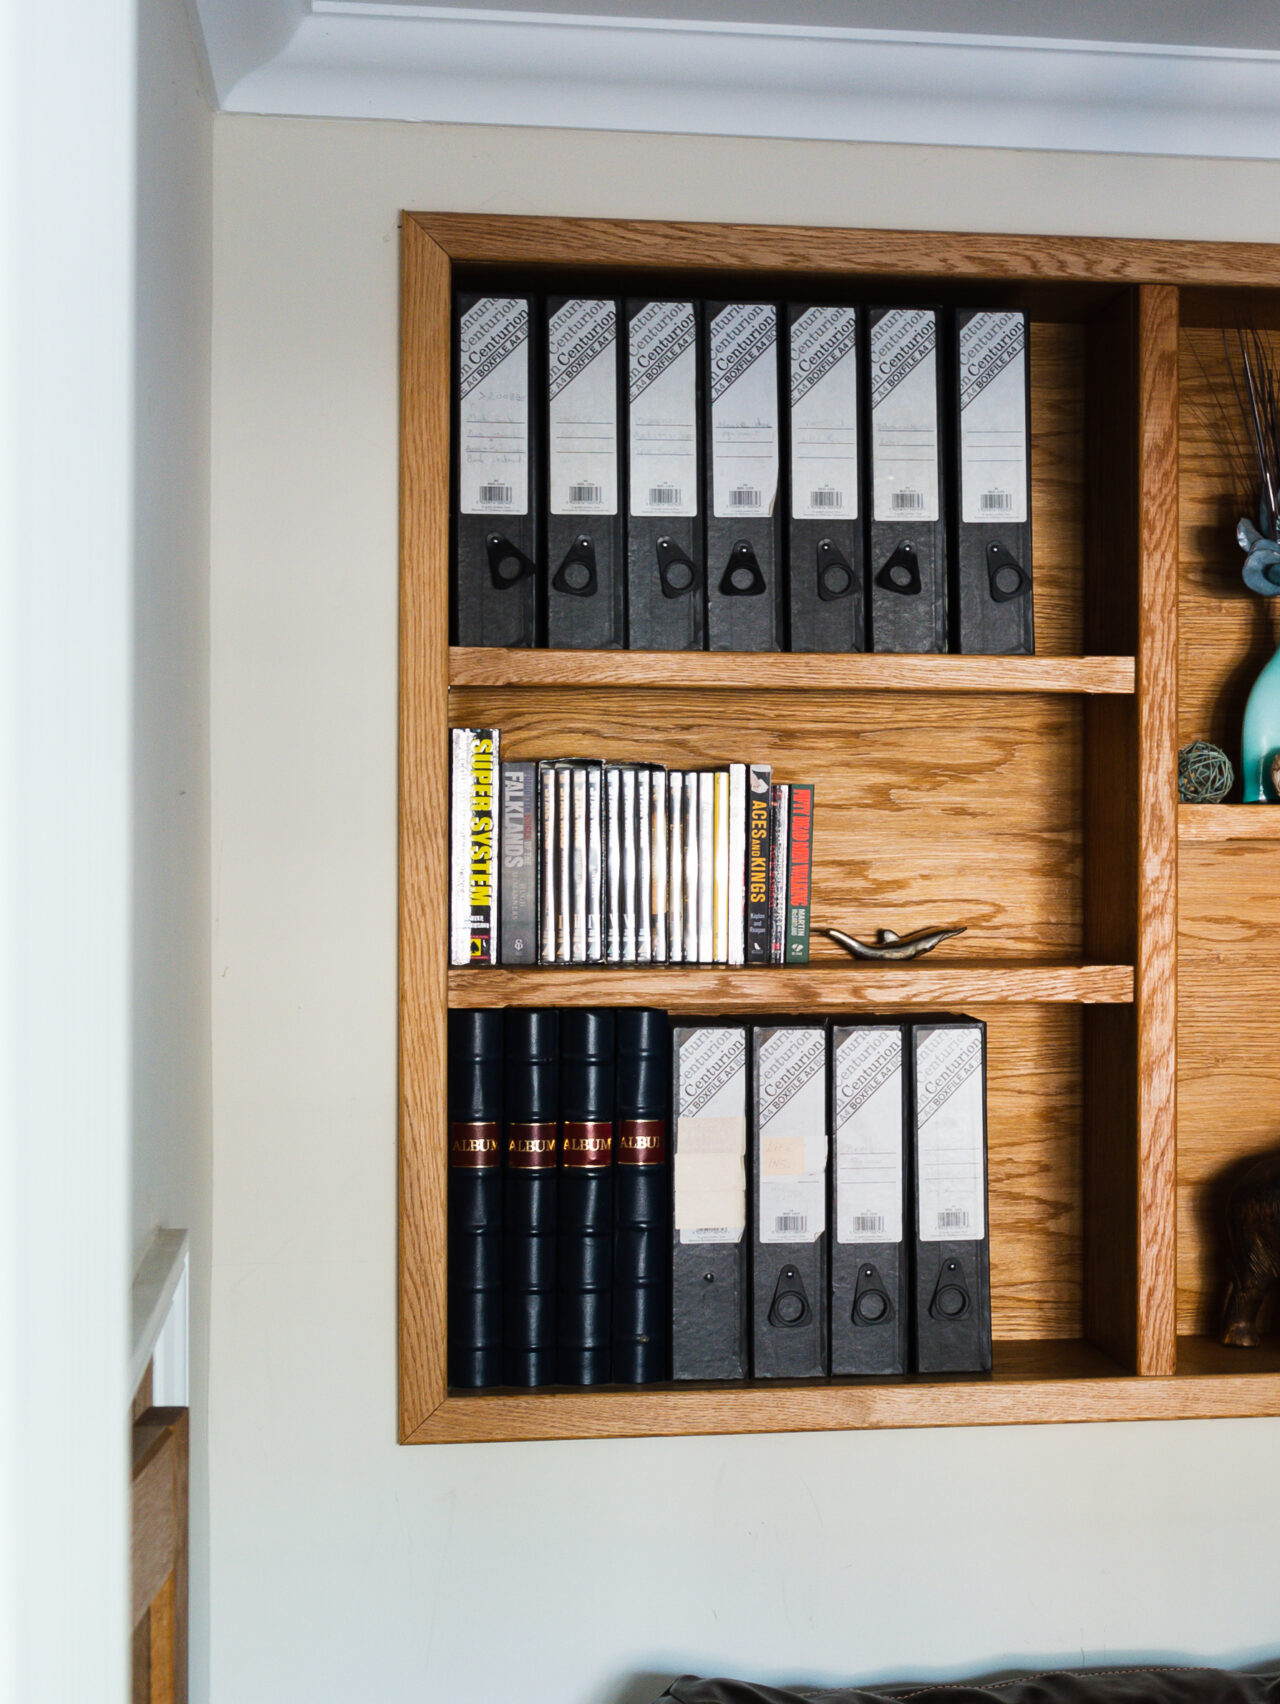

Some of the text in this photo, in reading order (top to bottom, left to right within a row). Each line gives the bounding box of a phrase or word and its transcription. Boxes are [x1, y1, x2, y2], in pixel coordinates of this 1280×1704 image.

[461, 298, 519, 353] Centurion
[468, 309, 528, 365] Centurion
[549, 301, 607, 355] Centurion
[557, 311, 616, 366] Centurion
[629, 303, 687, 357] Centurion
[637, 313, 695, 368] Centurion
[716, 315, 774, 371] Centurion
[791, 308, 847, 361] Centurion
[799, 318, 855, 373] Centurion
[871, 311, 927, 364] Centurion
[879, 320, 936, 375] Centurion
[960, 313, 1016, 365] Centurion
[967, 321, 1024, 377] Centurion
[477, 345, 510, 378] BOXFILE
[510, 335, 521, 347] A4
[565, 346, 598, 378] BOXFILE
[597, 336, 609, 348] A4
[645, 348, 678, 381] BOXFILE
[677, 338, 689, 350] A4
[724, 351, 757, 384] BOXFILE
[755, 340, 767, 353] A4
[806, 352, 839, 385] BOXFILE
[838, 342, 849, 355] A4
[887, 355, 920, 387] BOXFILE
[918, 345, 929, 357] A4
[976, 357, 1008, 388] BOXFILE
[1006, 346, 1017, 358] A4
[471, 739, 493, 811] SUPER
[504, 771, 524, 868] FALKLANDS
[470, 817, 494, 906] SYSTEM
[750, 800, 768, 903] ACES AND KINGS
[790, 789, 811, 906] FIFTY DEAD MEN WALKING
[797, 909, 806, 936] MARTIN
[685, 1040, 744, 1097] Centurion
[693, 1075, 725, 1109] BOXFILE
[724, 1066, 736, 1078] A4
[764, 1040, 823, 1097] Centurion
[772, 1075, 805, 1110] BOXFILE
[804, 1066, 815, 1078] A4
[842, 1041, 900, 1098] Centurion
[849, 1078, 881, 1110] BOXFILE
[881, 1067, 892, 1078] A4
[925, 1038, 981, 1094] Centurion
[933, 1073, 965, 1106] BOXFILE
[963, 1063, 974, 1075] A4
[509, 1139, 556, 1153] ALBUM
[563, 1137, 612, 1151] ALBUM
[620, 1135, 660, 1149] ALBU
